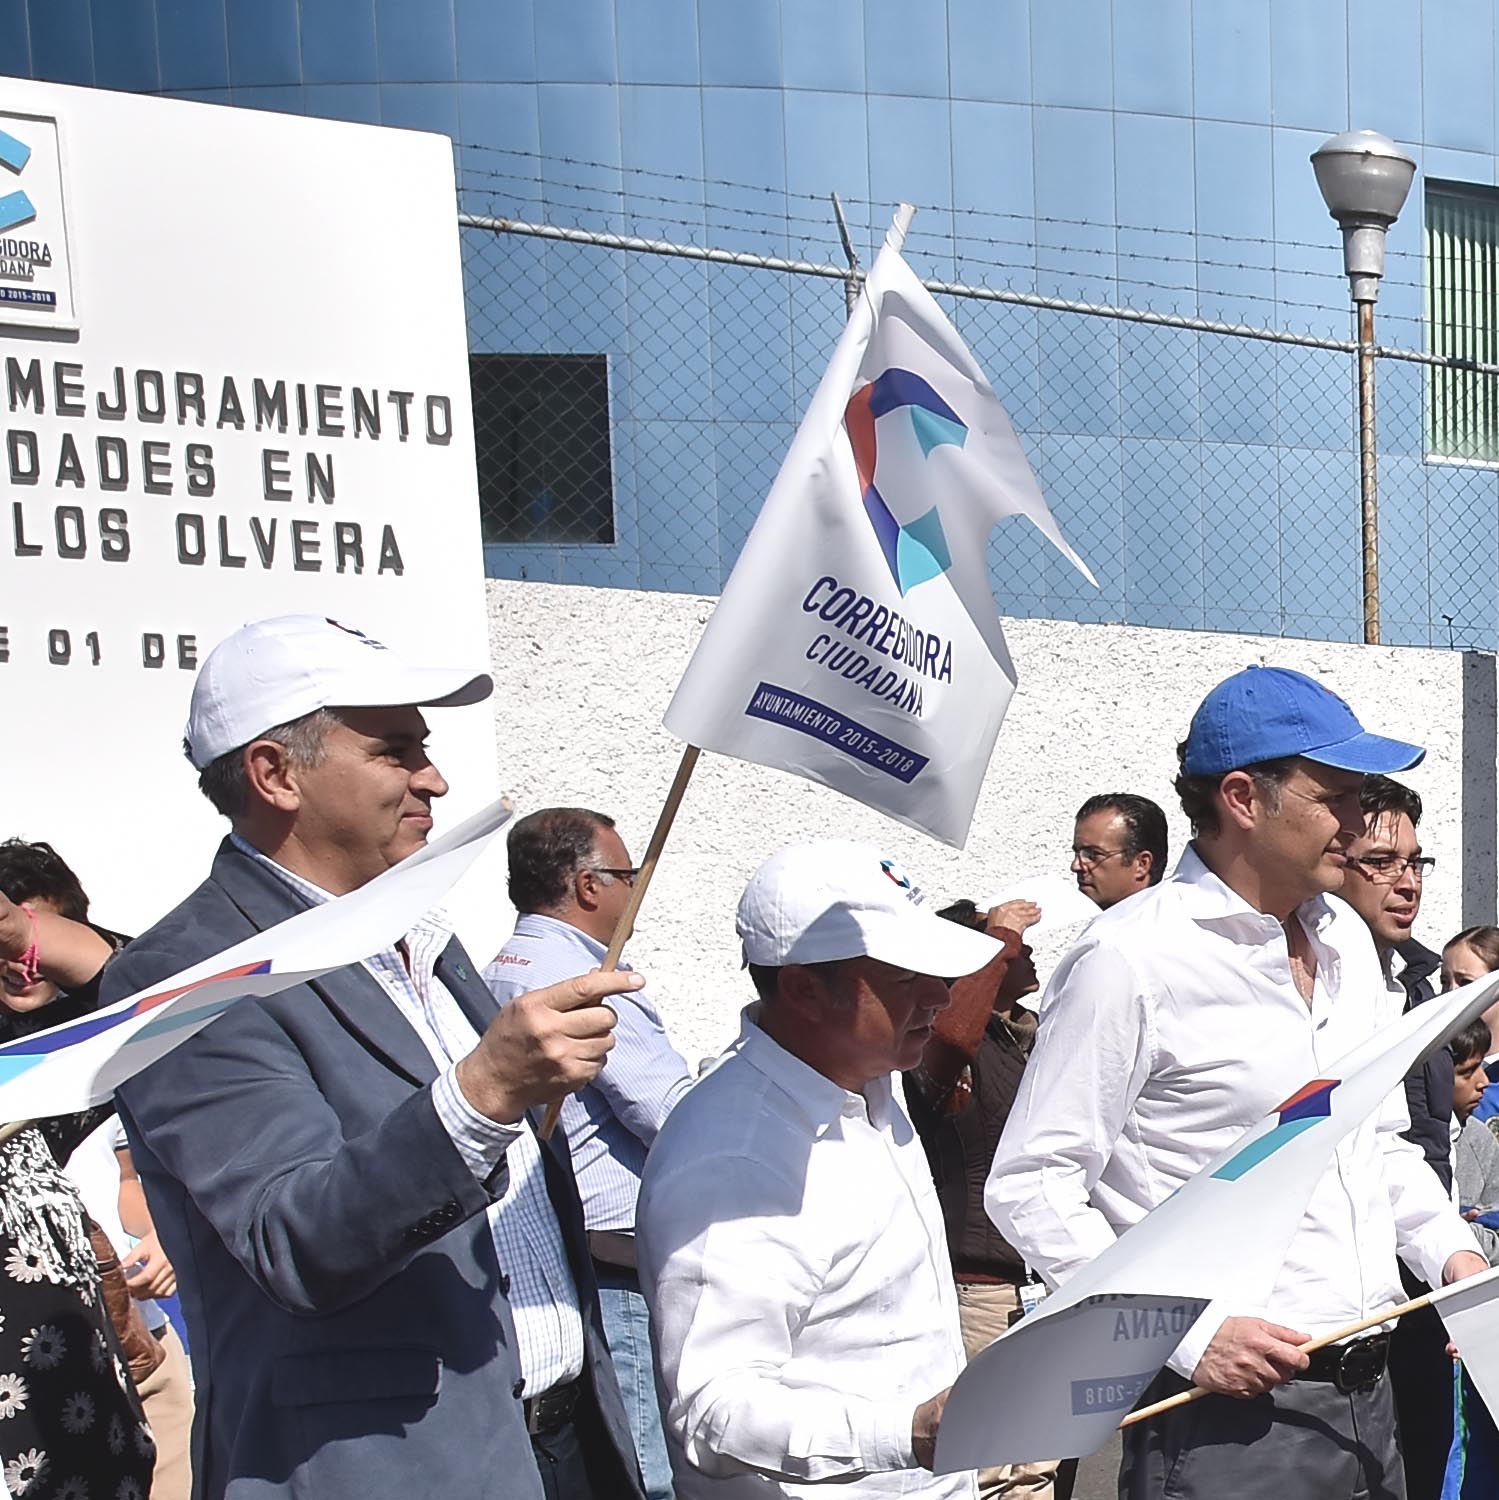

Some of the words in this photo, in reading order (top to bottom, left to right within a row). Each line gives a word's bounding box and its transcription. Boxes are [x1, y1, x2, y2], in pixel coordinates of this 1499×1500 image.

[0, 238, 52, 262] IDORA
[7, 290, 52, 302] 2015-2018
[5, 357, 453, 445] MEJORAMIENTO
[7, 430, 216, 497] DADES
[262, 448, 335, 505] EN
[12, 502, 131, 562] LOS
[176, 512, 404, 576] OLVERA
[48, 629, 101, 666] 01
[142, 633, 198, 670] DE
[801, 575, 954, 686] CORREGIDORA
[805, 633, 923, 719] CIUDADANA
[754, 689, 840, 737] AYUNTAMIENTO
[839, 721, 916, 774] 2015-2018
